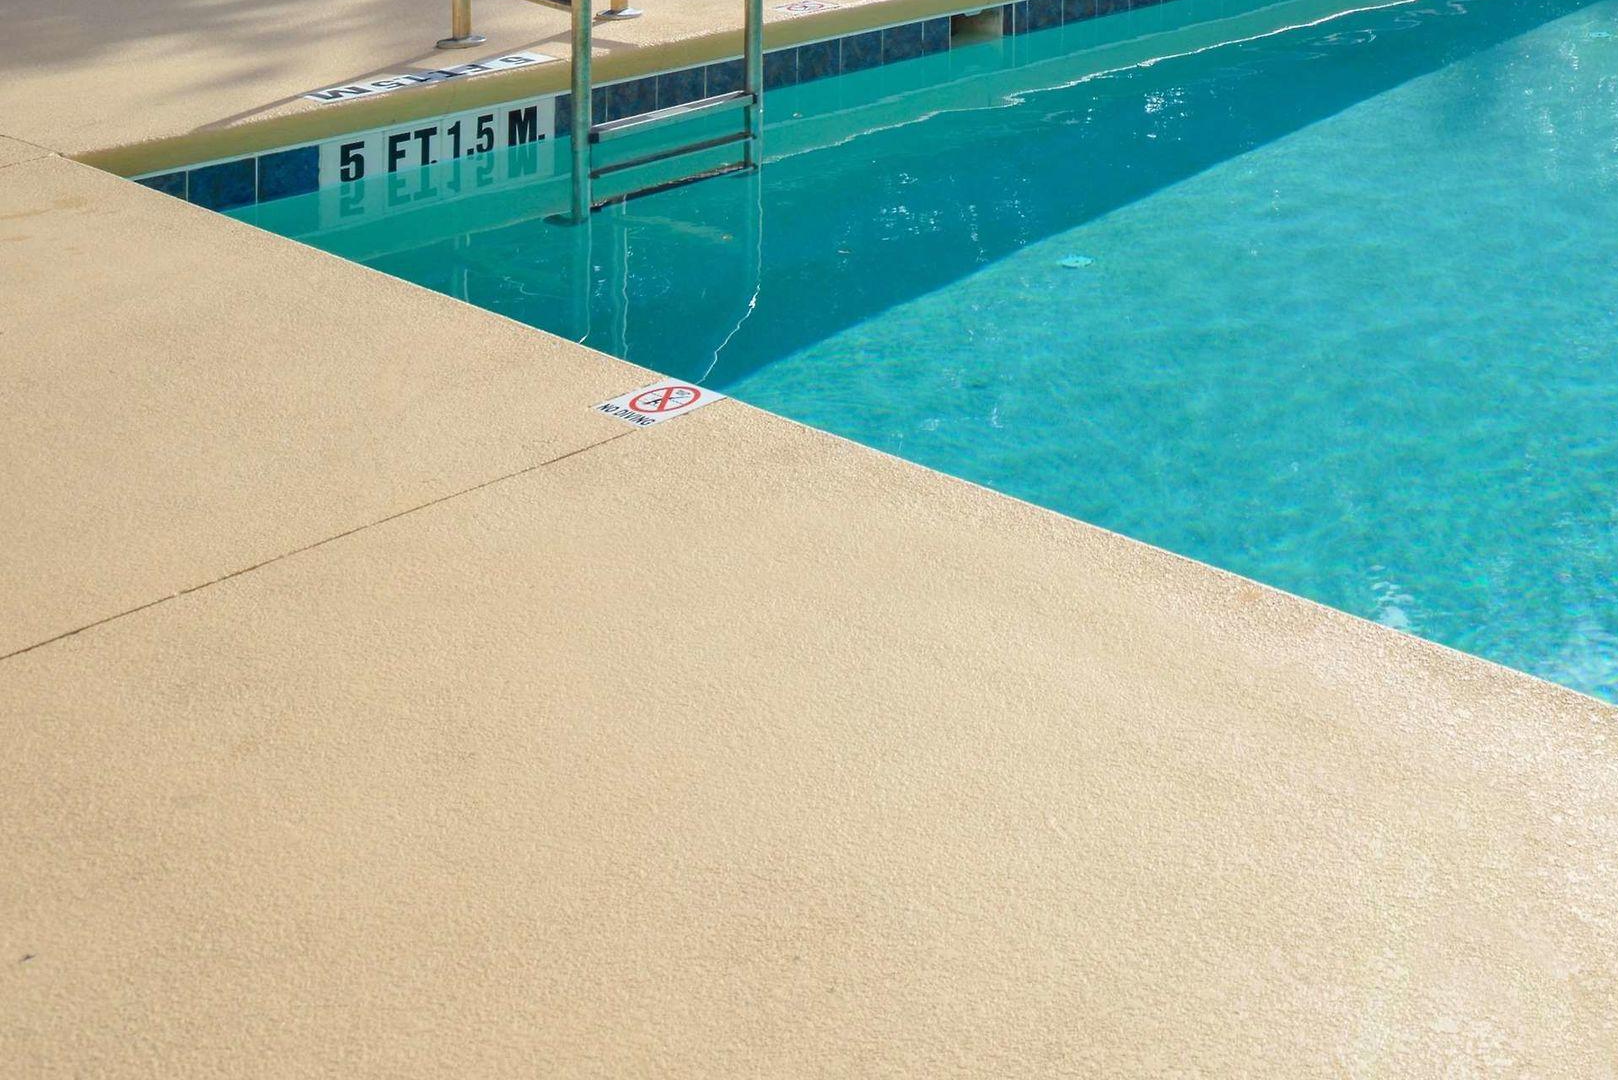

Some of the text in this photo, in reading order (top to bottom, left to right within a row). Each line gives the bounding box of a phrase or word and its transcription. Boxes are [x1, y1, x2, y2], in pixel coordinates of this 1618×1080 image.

[499, 56, 535, 65] 5
[308, 86, 371, 101] M
[339, 141, 365, 183] 5
[447, 113, 495, 159] 1.5
[596, 403, 655, 426] NO DIVING
